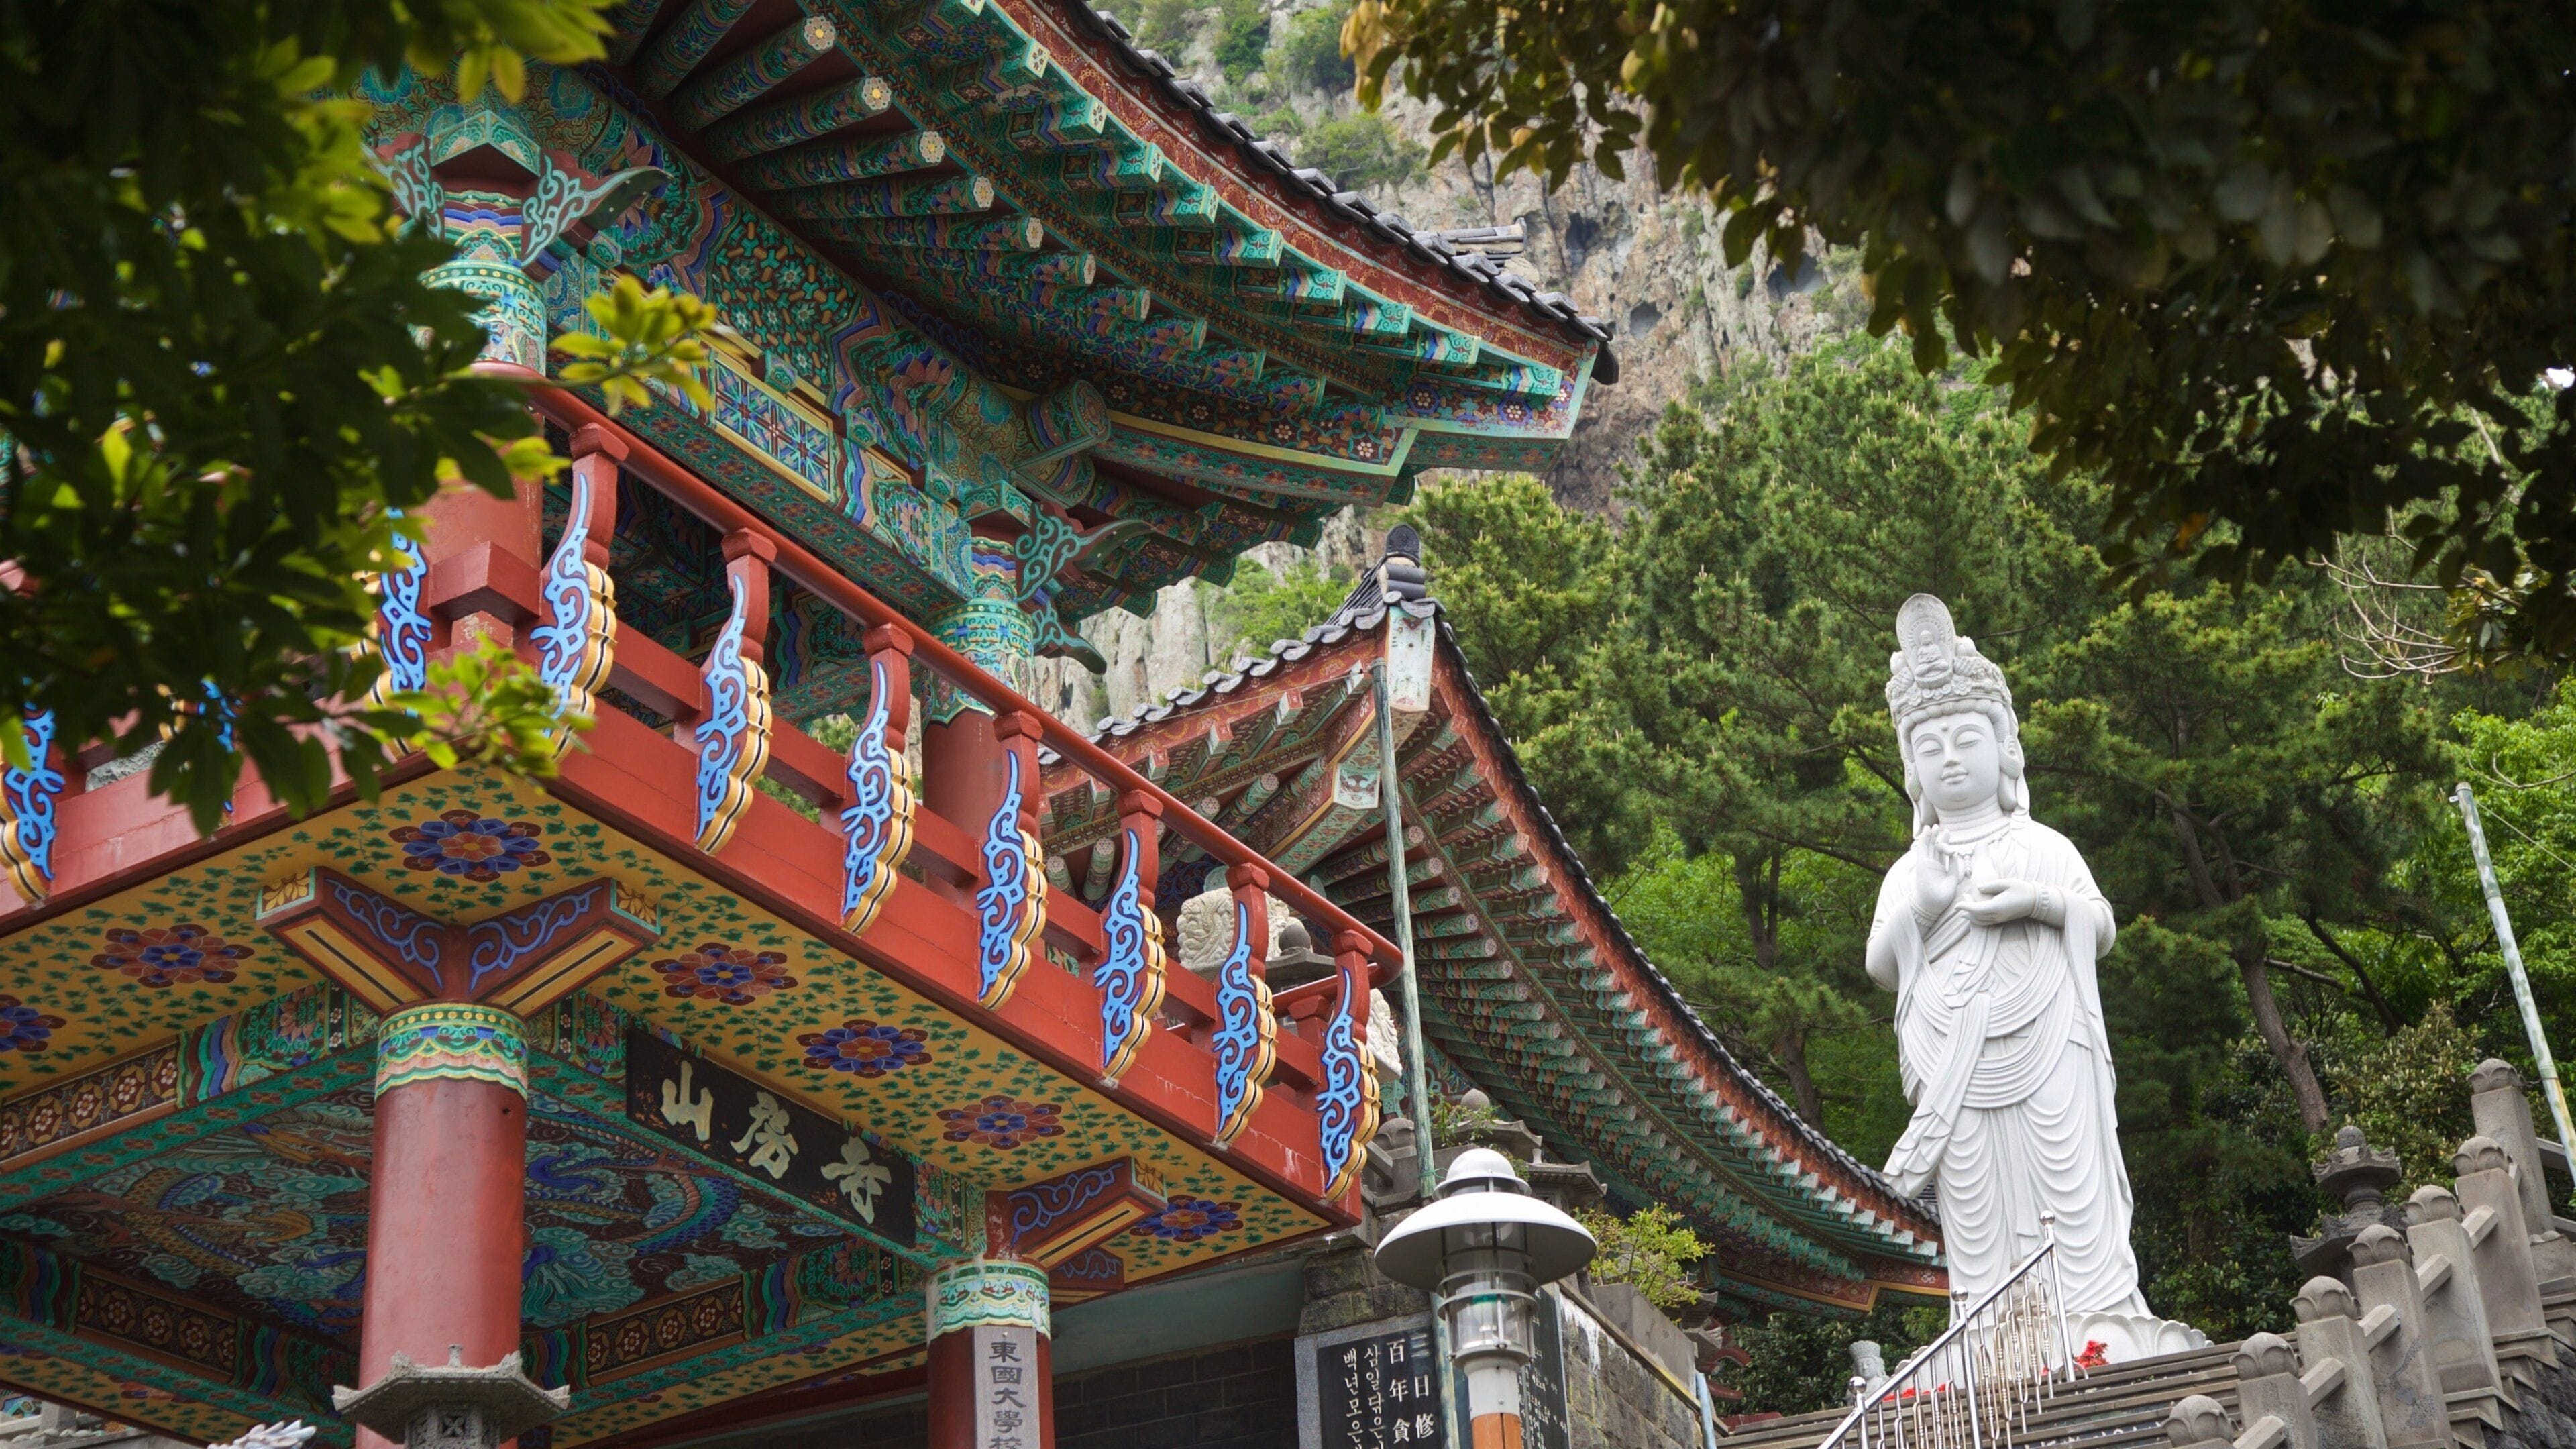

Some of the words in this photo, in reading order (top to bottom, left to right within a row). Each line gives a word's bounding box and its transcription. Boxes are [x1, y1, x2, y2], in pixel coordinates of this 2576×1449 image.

[1343, 1348, 1363, 1449] 백년모은
[1388, 1338, 1411, 1444] 百年貪
